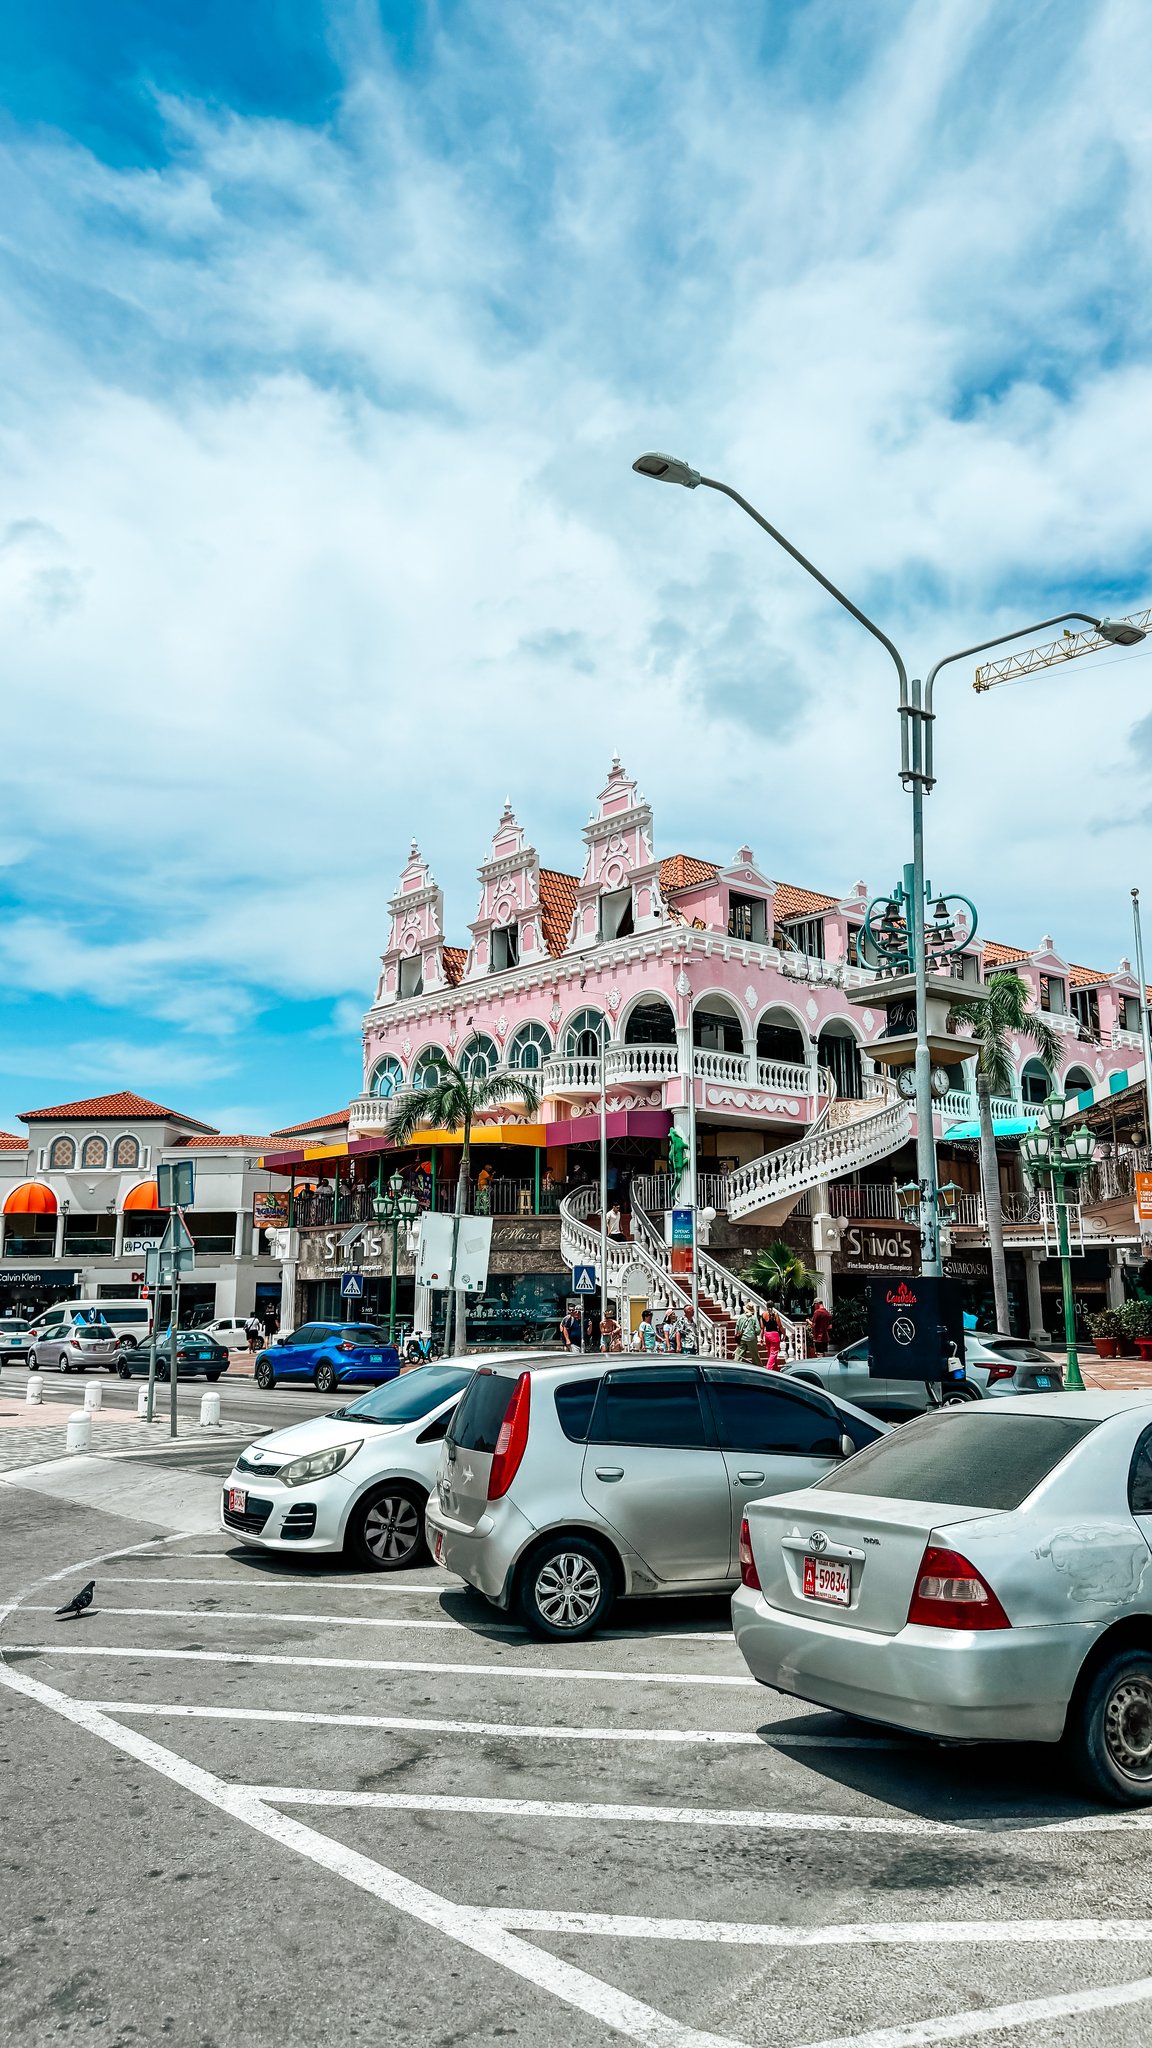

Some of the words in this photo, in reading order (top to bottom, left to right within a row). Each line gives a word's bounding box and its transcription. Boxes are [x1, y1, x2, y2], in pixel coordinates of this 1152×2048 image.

[504, 1227, 540, 1240] Plaza
[847, 1229, 912, 1261] Shiva's
[622, 1263, 653, 1284] DIRECTORY
[947, 1261, 988, 1275] SWAROVSKI
[22, 1273, 41, 1282] Klein
